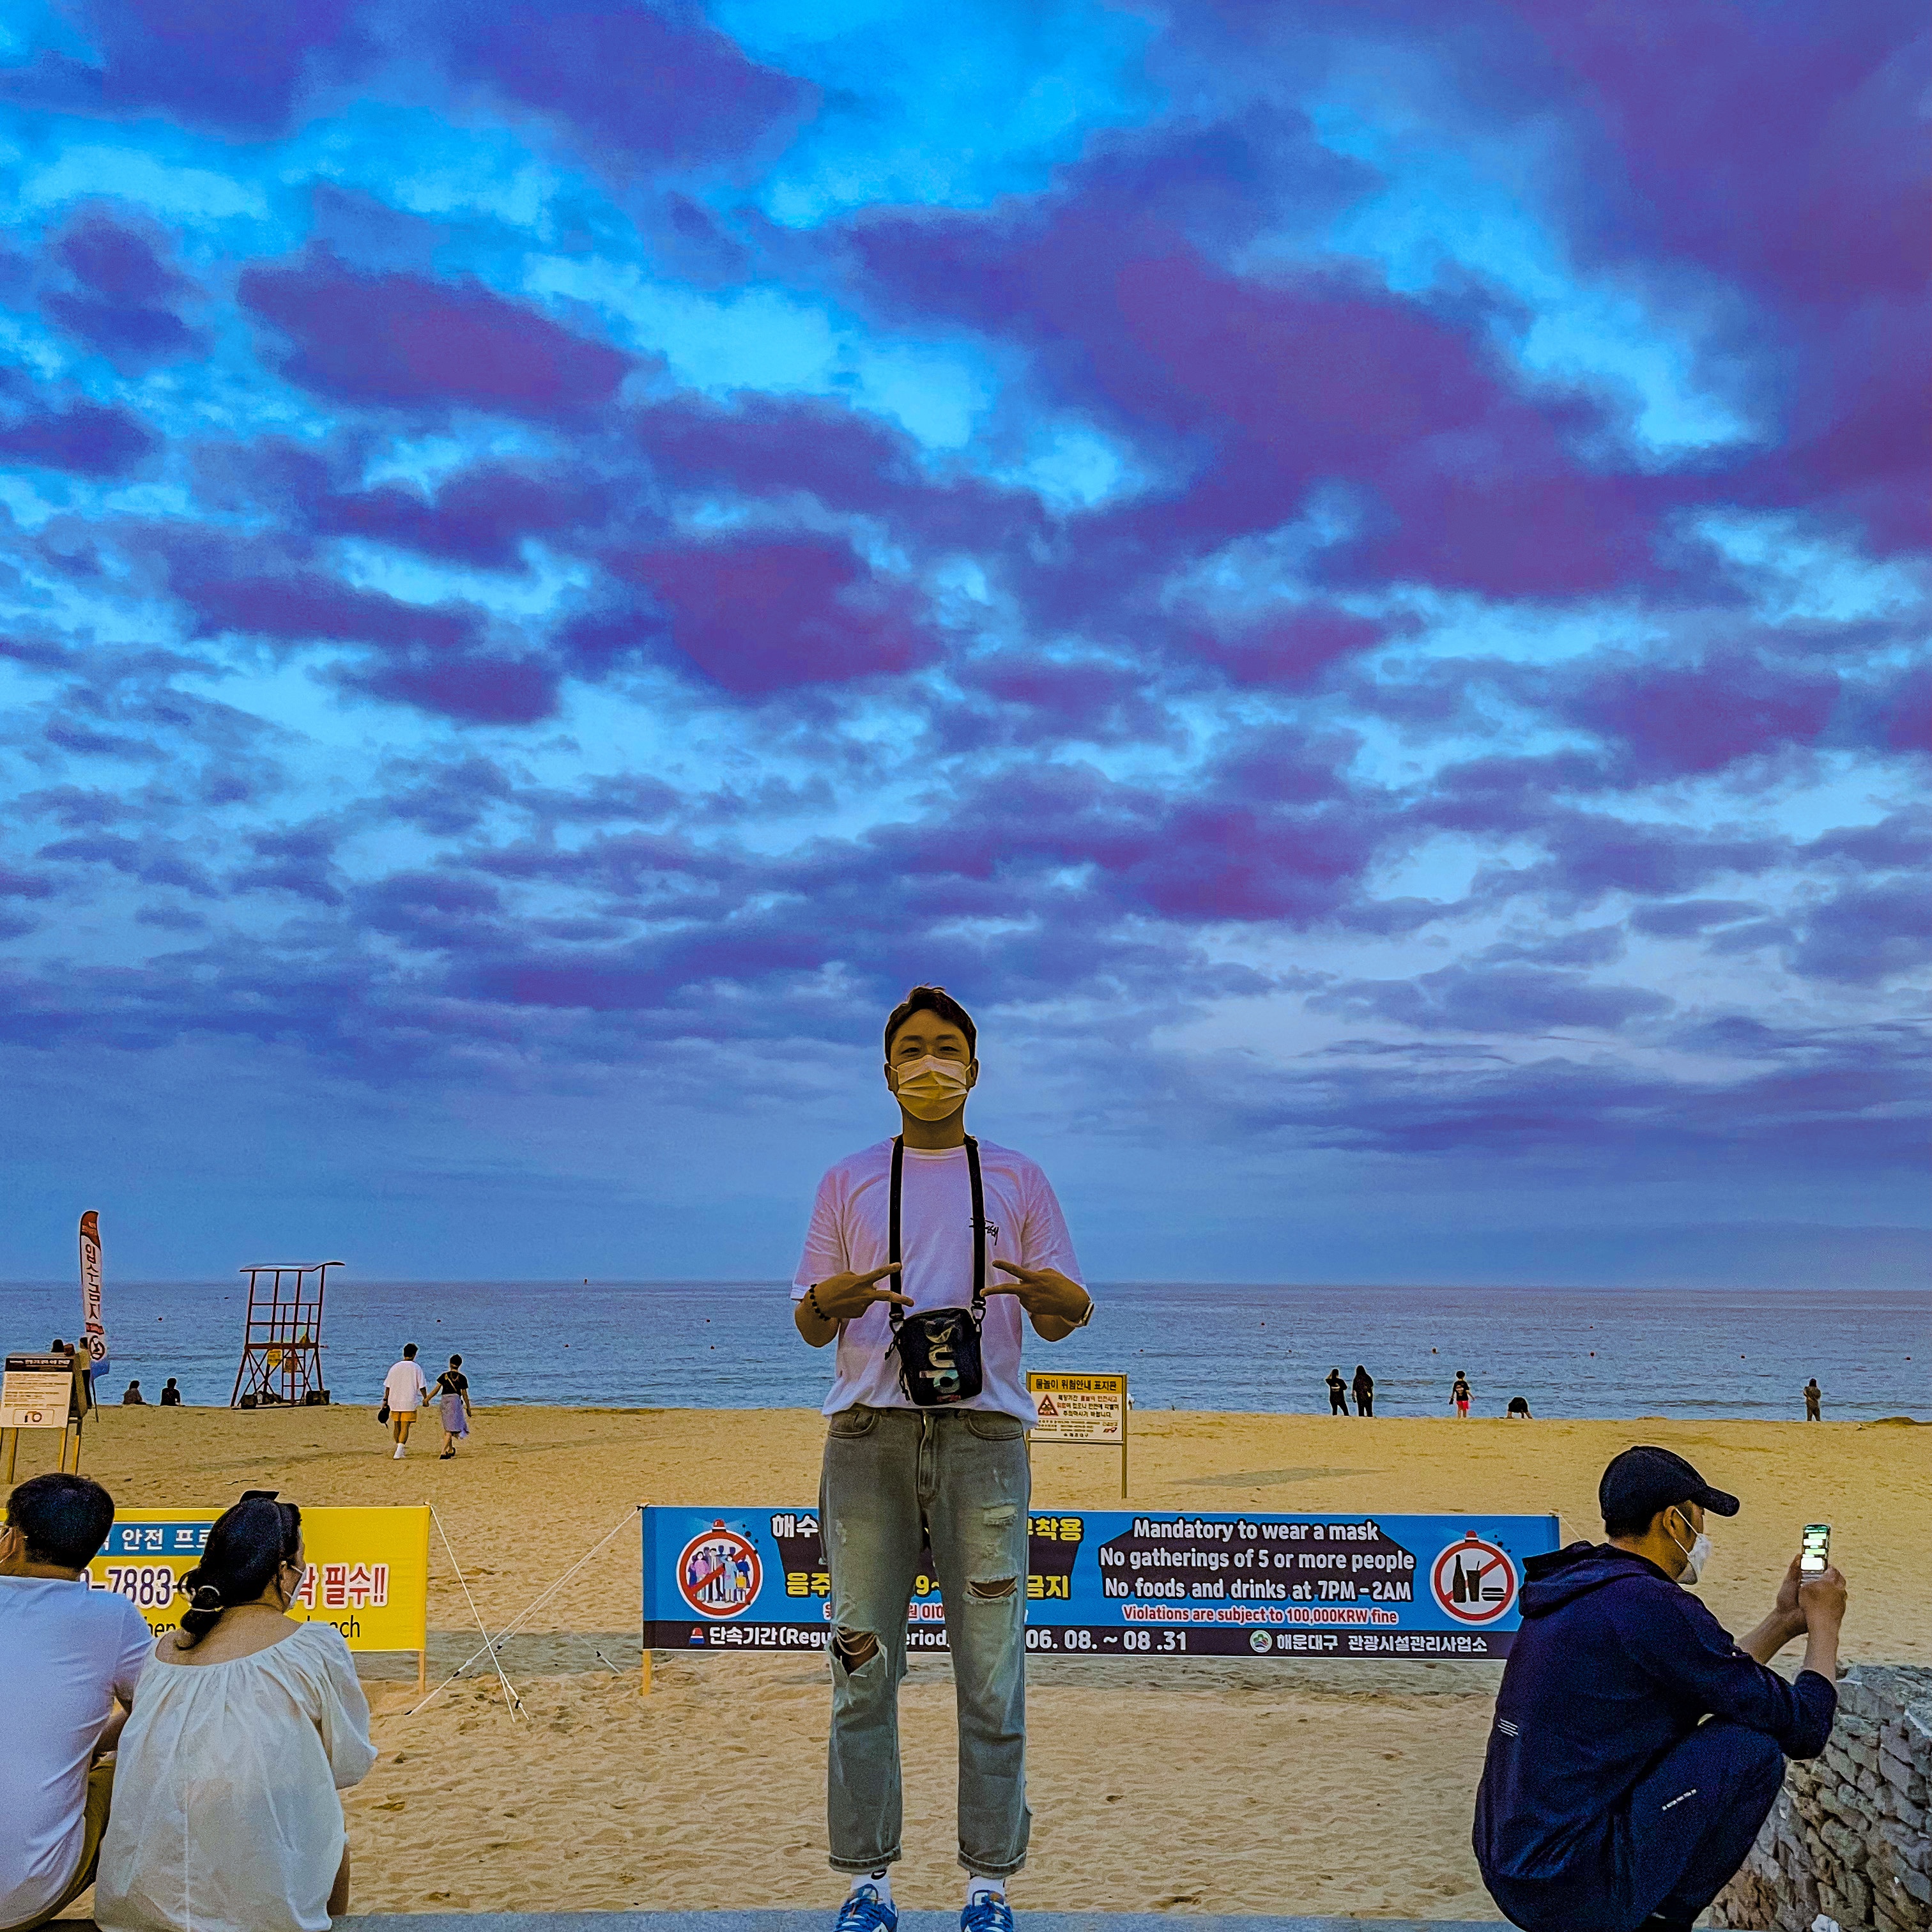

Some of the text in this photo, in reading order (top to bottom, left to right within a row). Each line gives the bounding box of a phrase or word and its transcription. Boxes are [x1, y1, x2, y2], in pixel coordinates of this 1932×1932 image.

[85, 1243, 100, 1320] 입수금지
[1036, 1378, 1117, 1392] 물놀이 위험안내 표지판
[772, 1515, 819, 1538] 해수
[1133, 1519, 1380, 1542] Mandatory to wear a mask
[122, 1528, 163, 1551] 안전
[1100, 1547, 1414, 1573] No gatherings of 5 or more people
[325, 1566, 386, 1606] 필수!!
[1105, 1577, 1129, 1597] No
[1135, 1577, 1185, 1597] foods
[1192, 1578, 1224, 1598] and
[1230, 1578, 1286, 1599] drinks
[1292, 1581, 1312, 1600] at
[1123, 1606, 1397, 1625] Violations are subject to 100,000KRW fine
[1025, 1629, 1058, 1650] 06.
[1064, 1629, 1098, 1650] 08.
[1277, 1633, 1488, 1653] 해운대구 관광시설관리사업소
